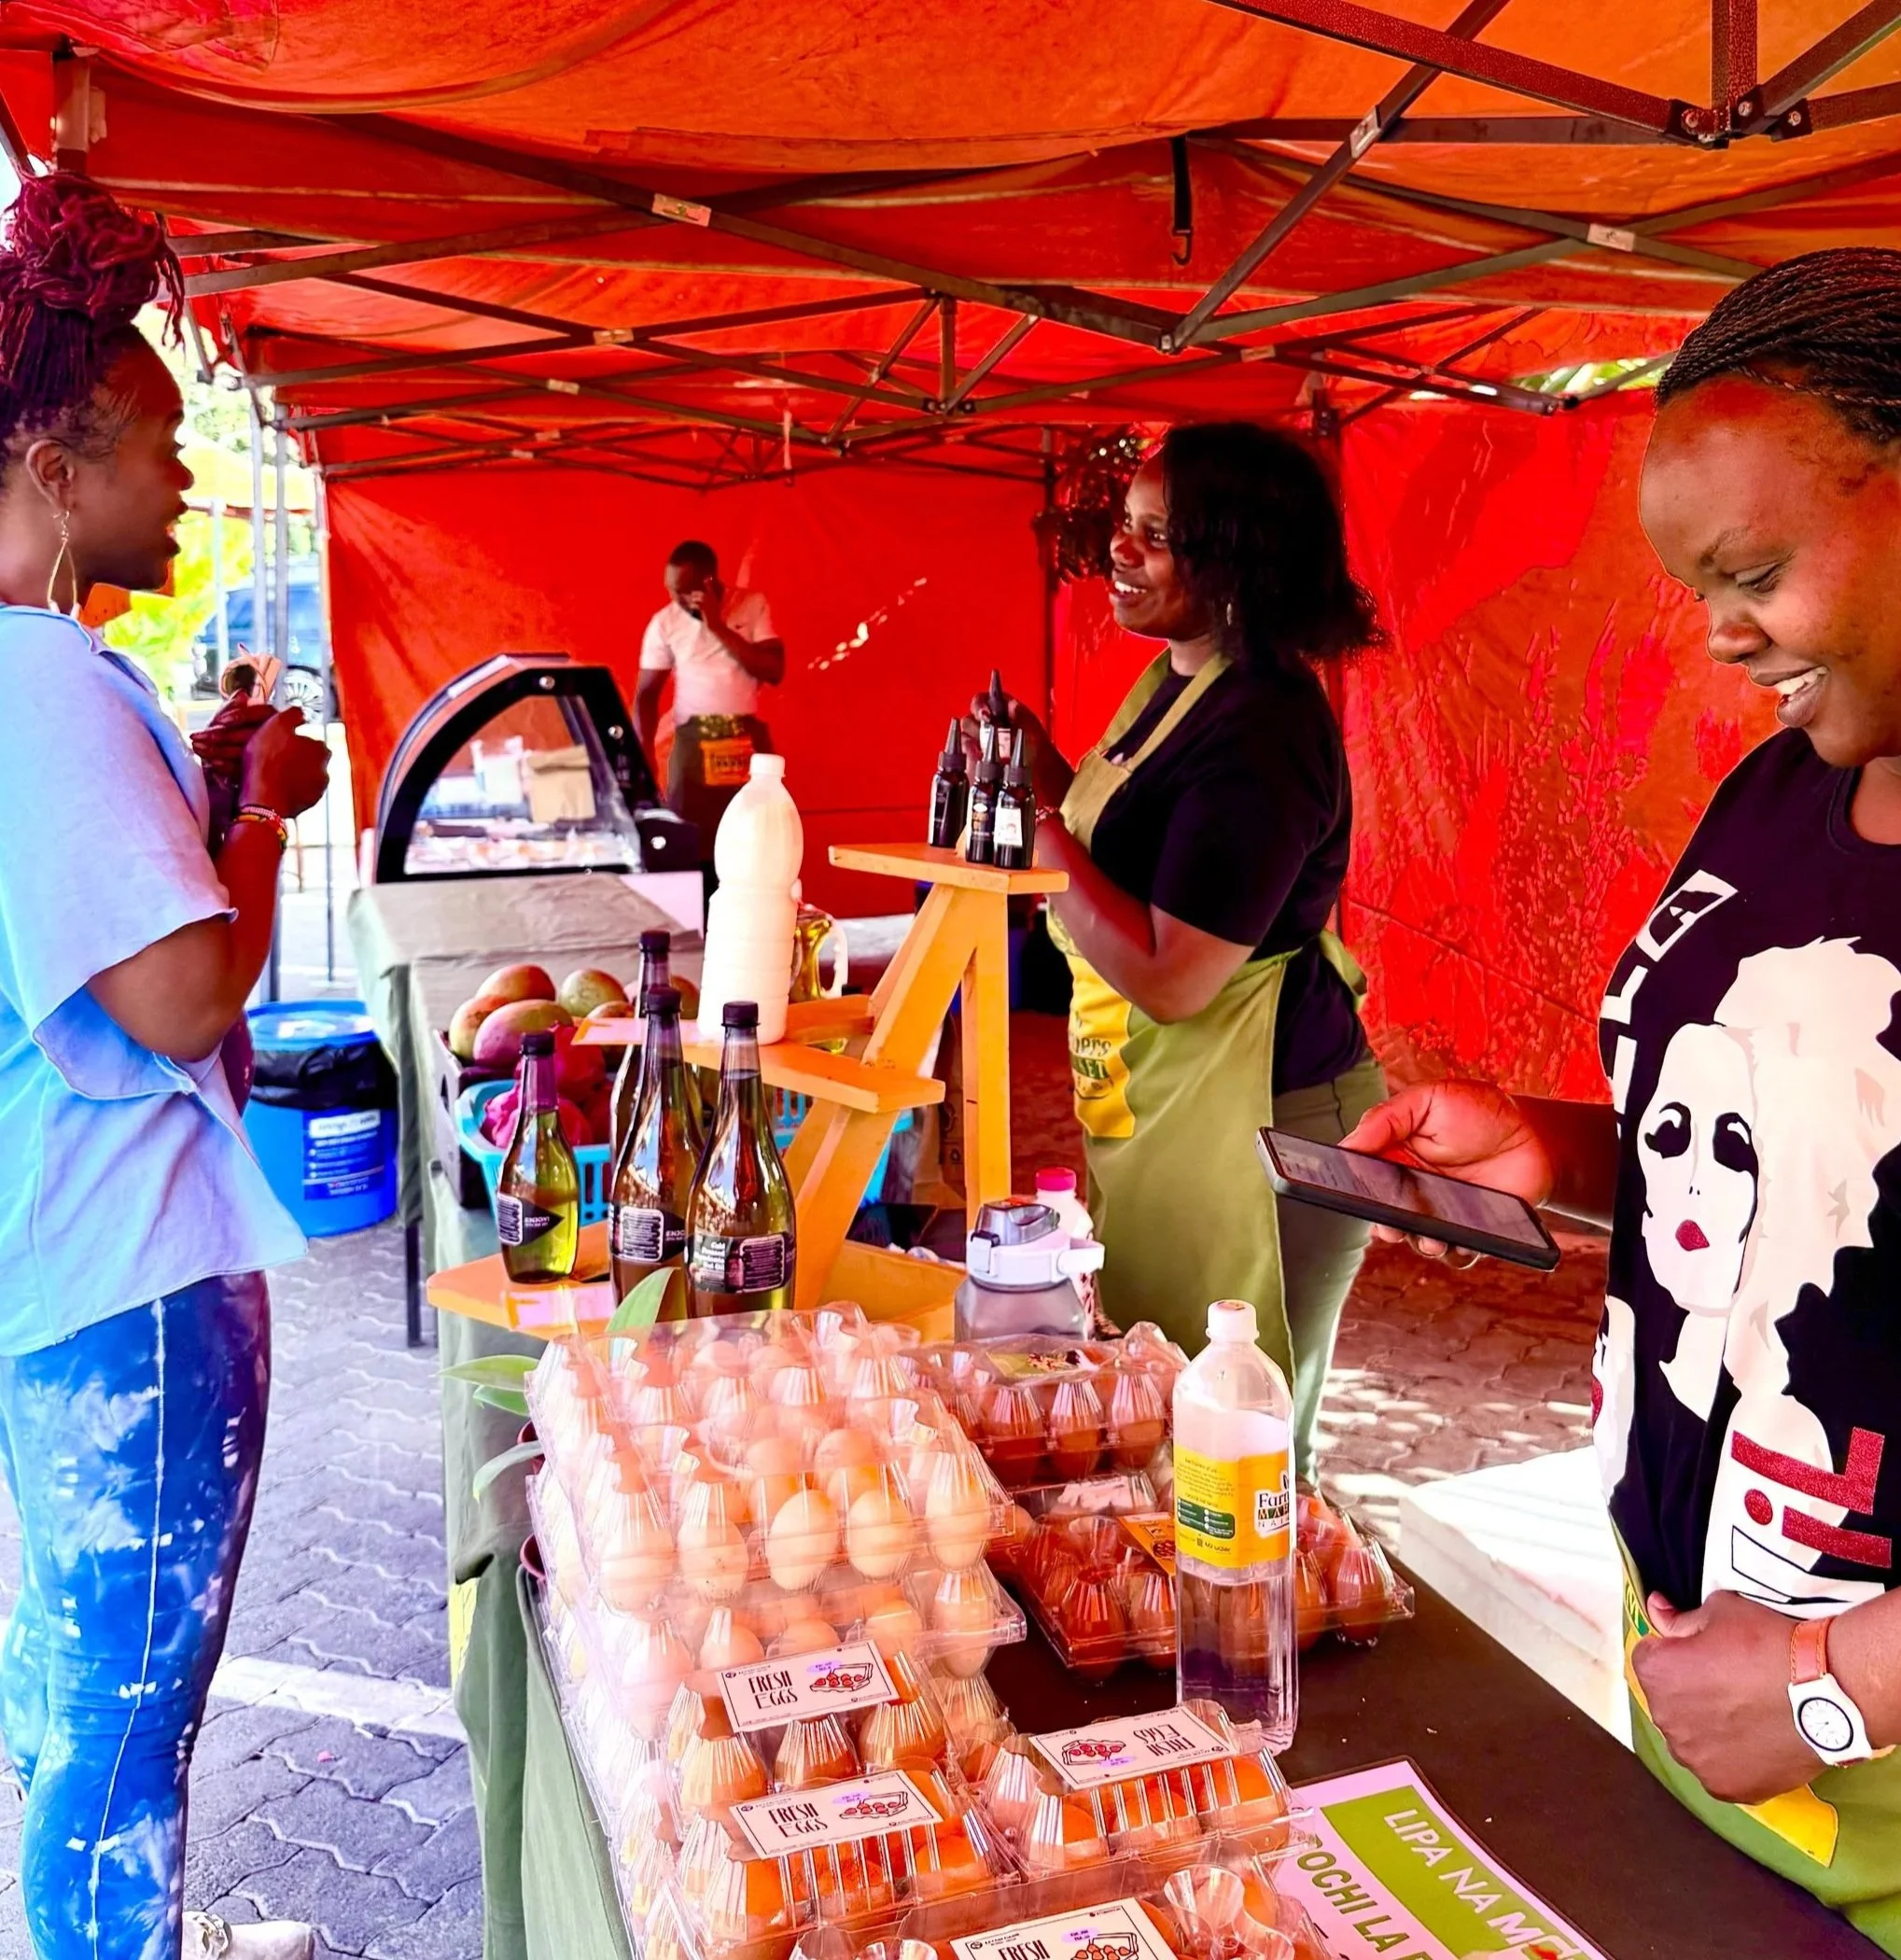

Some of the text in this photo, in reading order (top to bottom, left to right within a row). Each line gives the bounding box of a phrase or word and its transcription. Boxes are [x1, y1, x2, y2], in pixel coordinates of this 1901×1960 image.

[748, 1670, 793, 1693] FRESH
[755, 1688, 798, 1709] EGGS
[1133, 1725, 1181, 1744] EGGS
[1145, 1736, 1196, 1757] FRESH
[768, 1802, 819, 1825] FRESH
[778, 1817, 828, 1838] EGGS
[1384, 1809, 1454, 1867] LIPA
[1438, 1867, 1503, 1914] NA
[1352, 1913, 1412, 1953] LA
[998, 1939, 1051, 1960] FRESH
